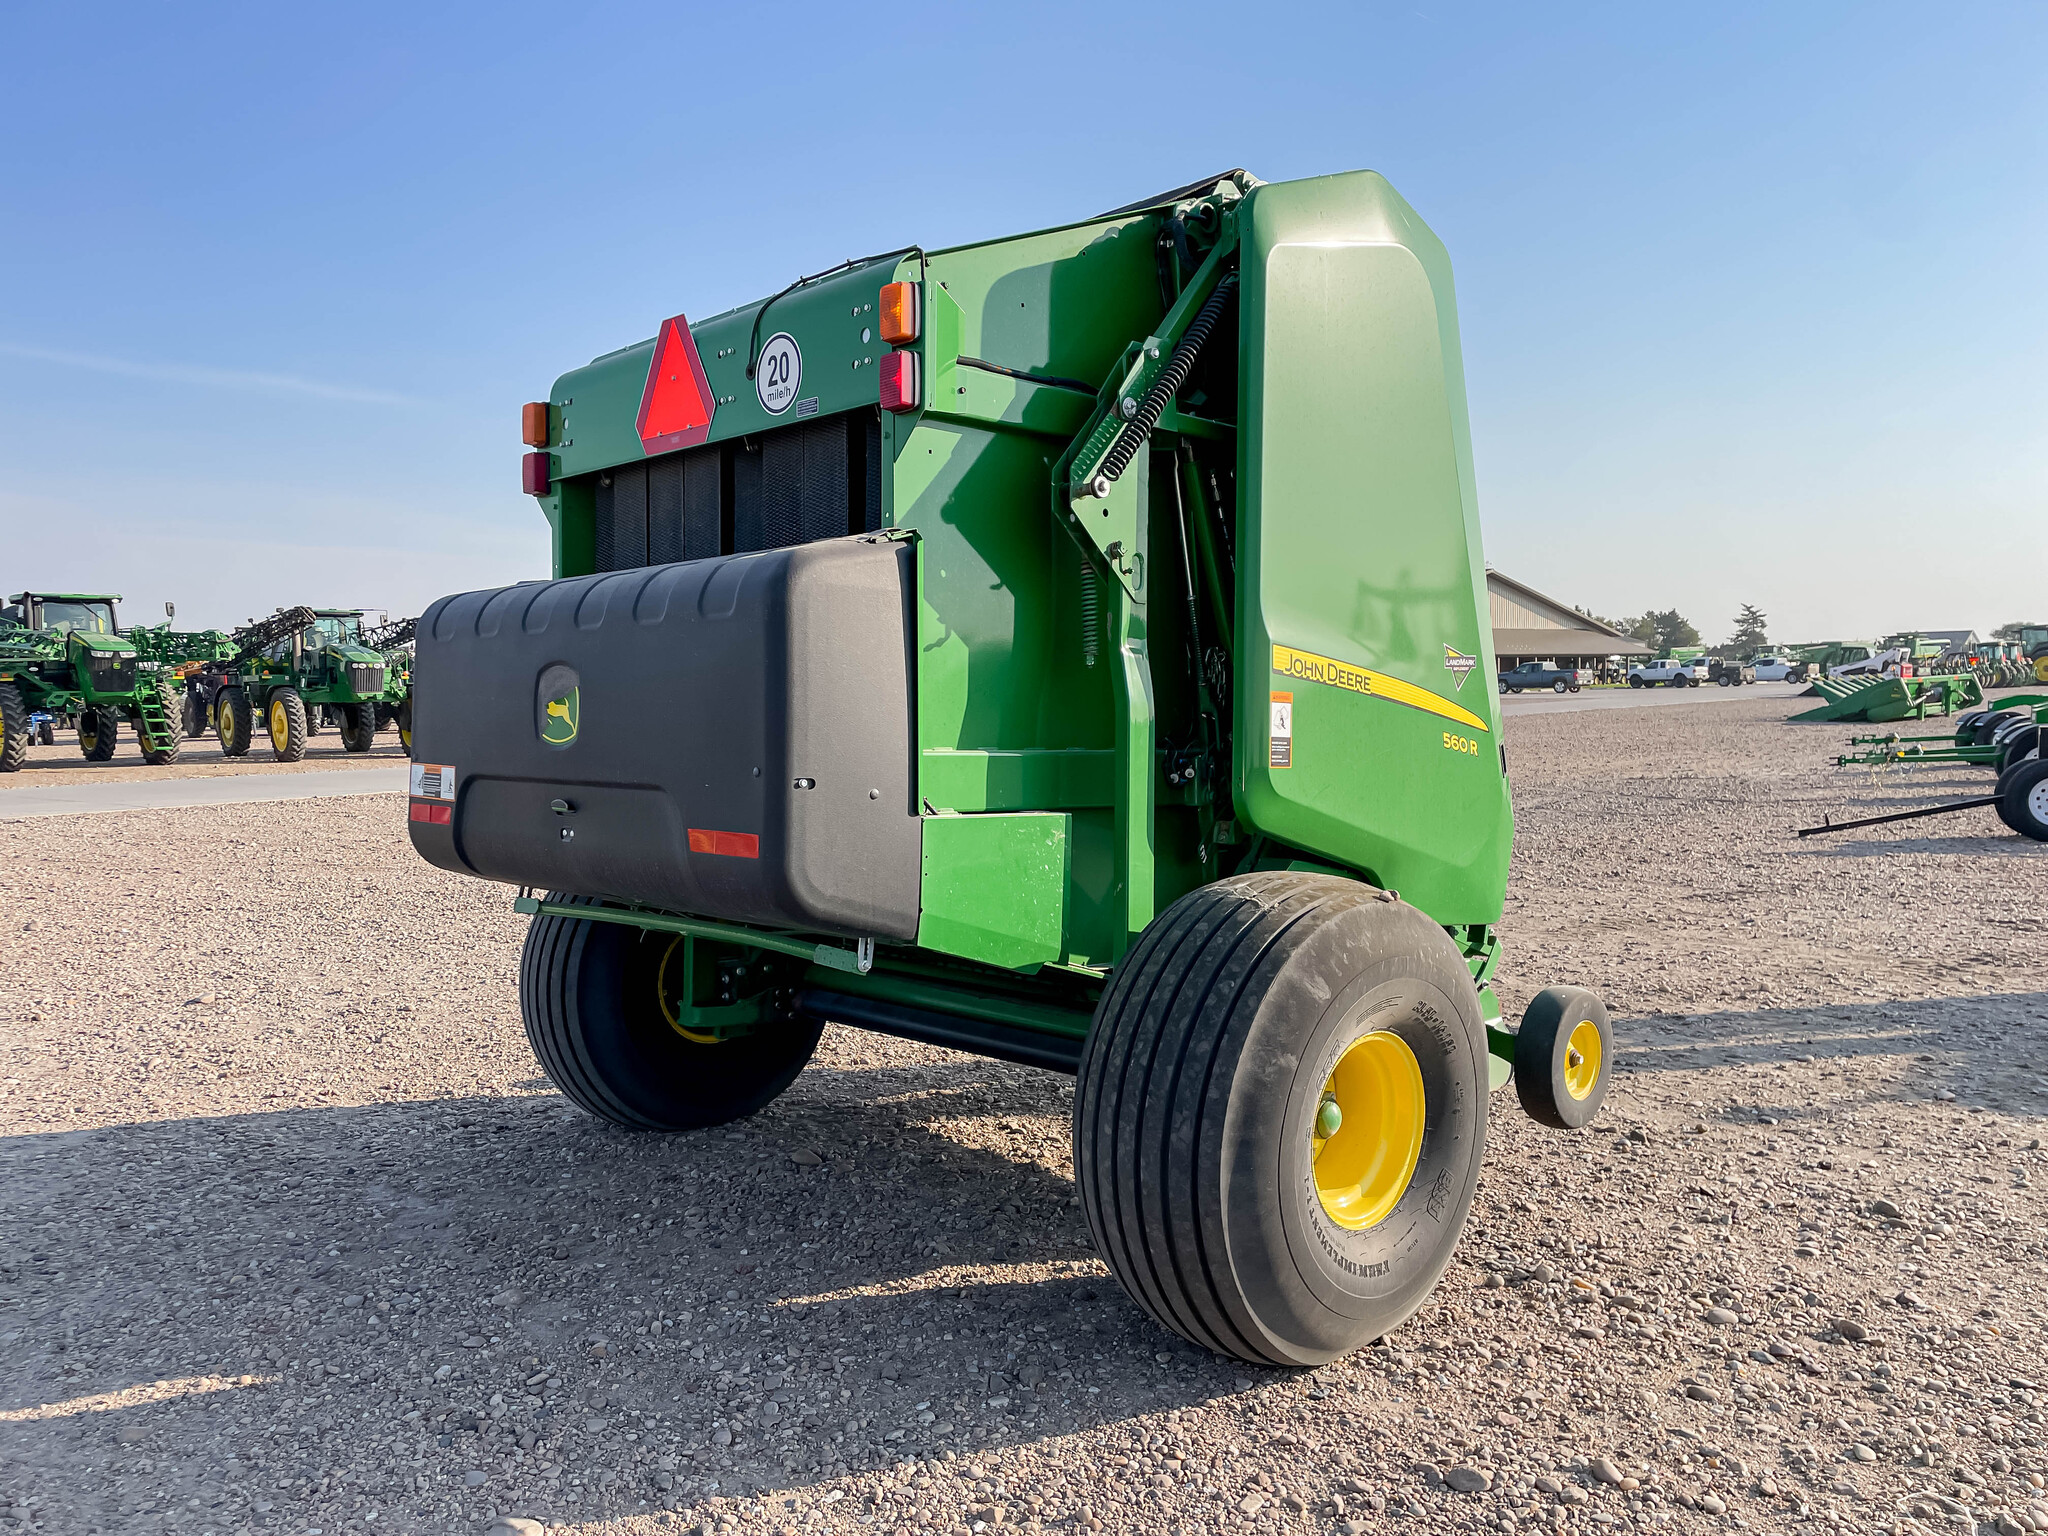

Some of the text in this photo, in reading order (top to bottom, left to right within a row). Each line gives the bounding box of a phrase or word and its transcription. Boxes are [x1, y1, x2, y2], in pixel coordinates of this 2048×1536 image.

[767, 351, 790, 387] 20
[767, 386, 791, 402] mile/h
[1285, 653, 1371, 692] JOHN DEERE
[1442, 731, 1479, 757] 560 R
